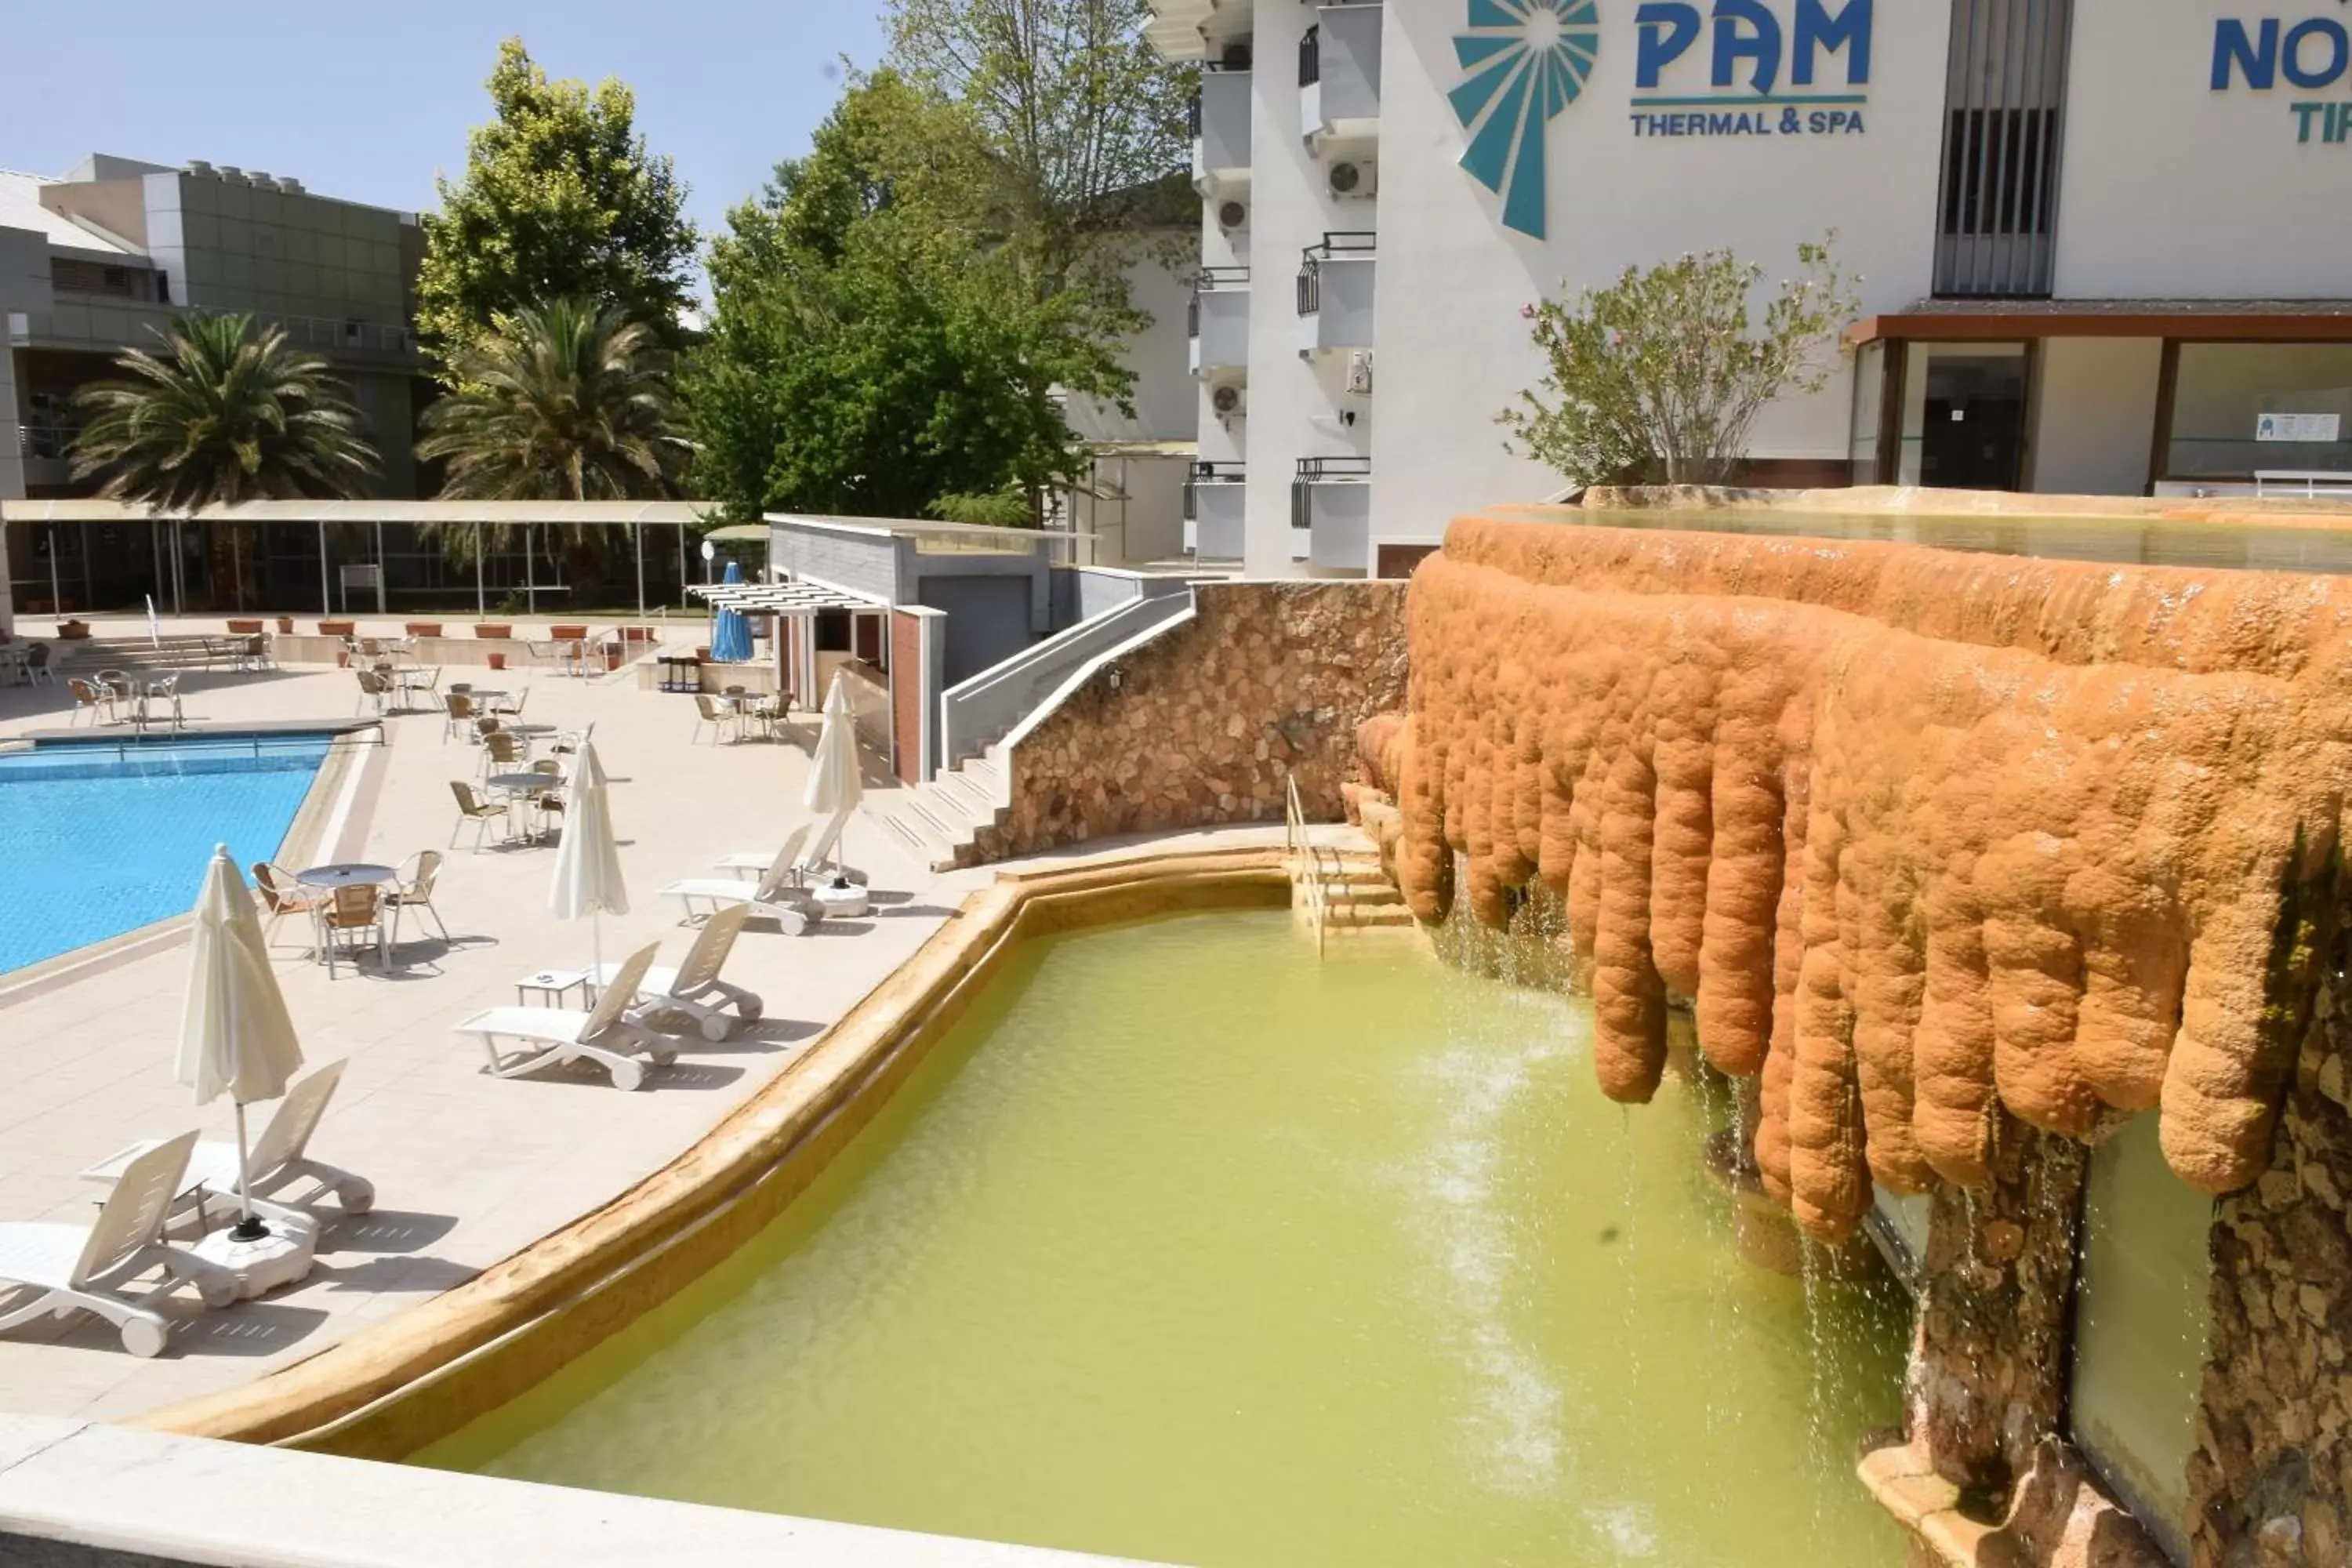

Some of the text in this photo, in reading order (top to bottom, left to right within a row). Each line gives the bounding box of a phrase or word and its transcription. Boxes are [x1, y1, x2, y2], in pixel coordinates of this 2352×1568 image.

[1635, 0, 1873, 95] PAM
[1630, 107, 1864, 137] THERMAL & SPA
